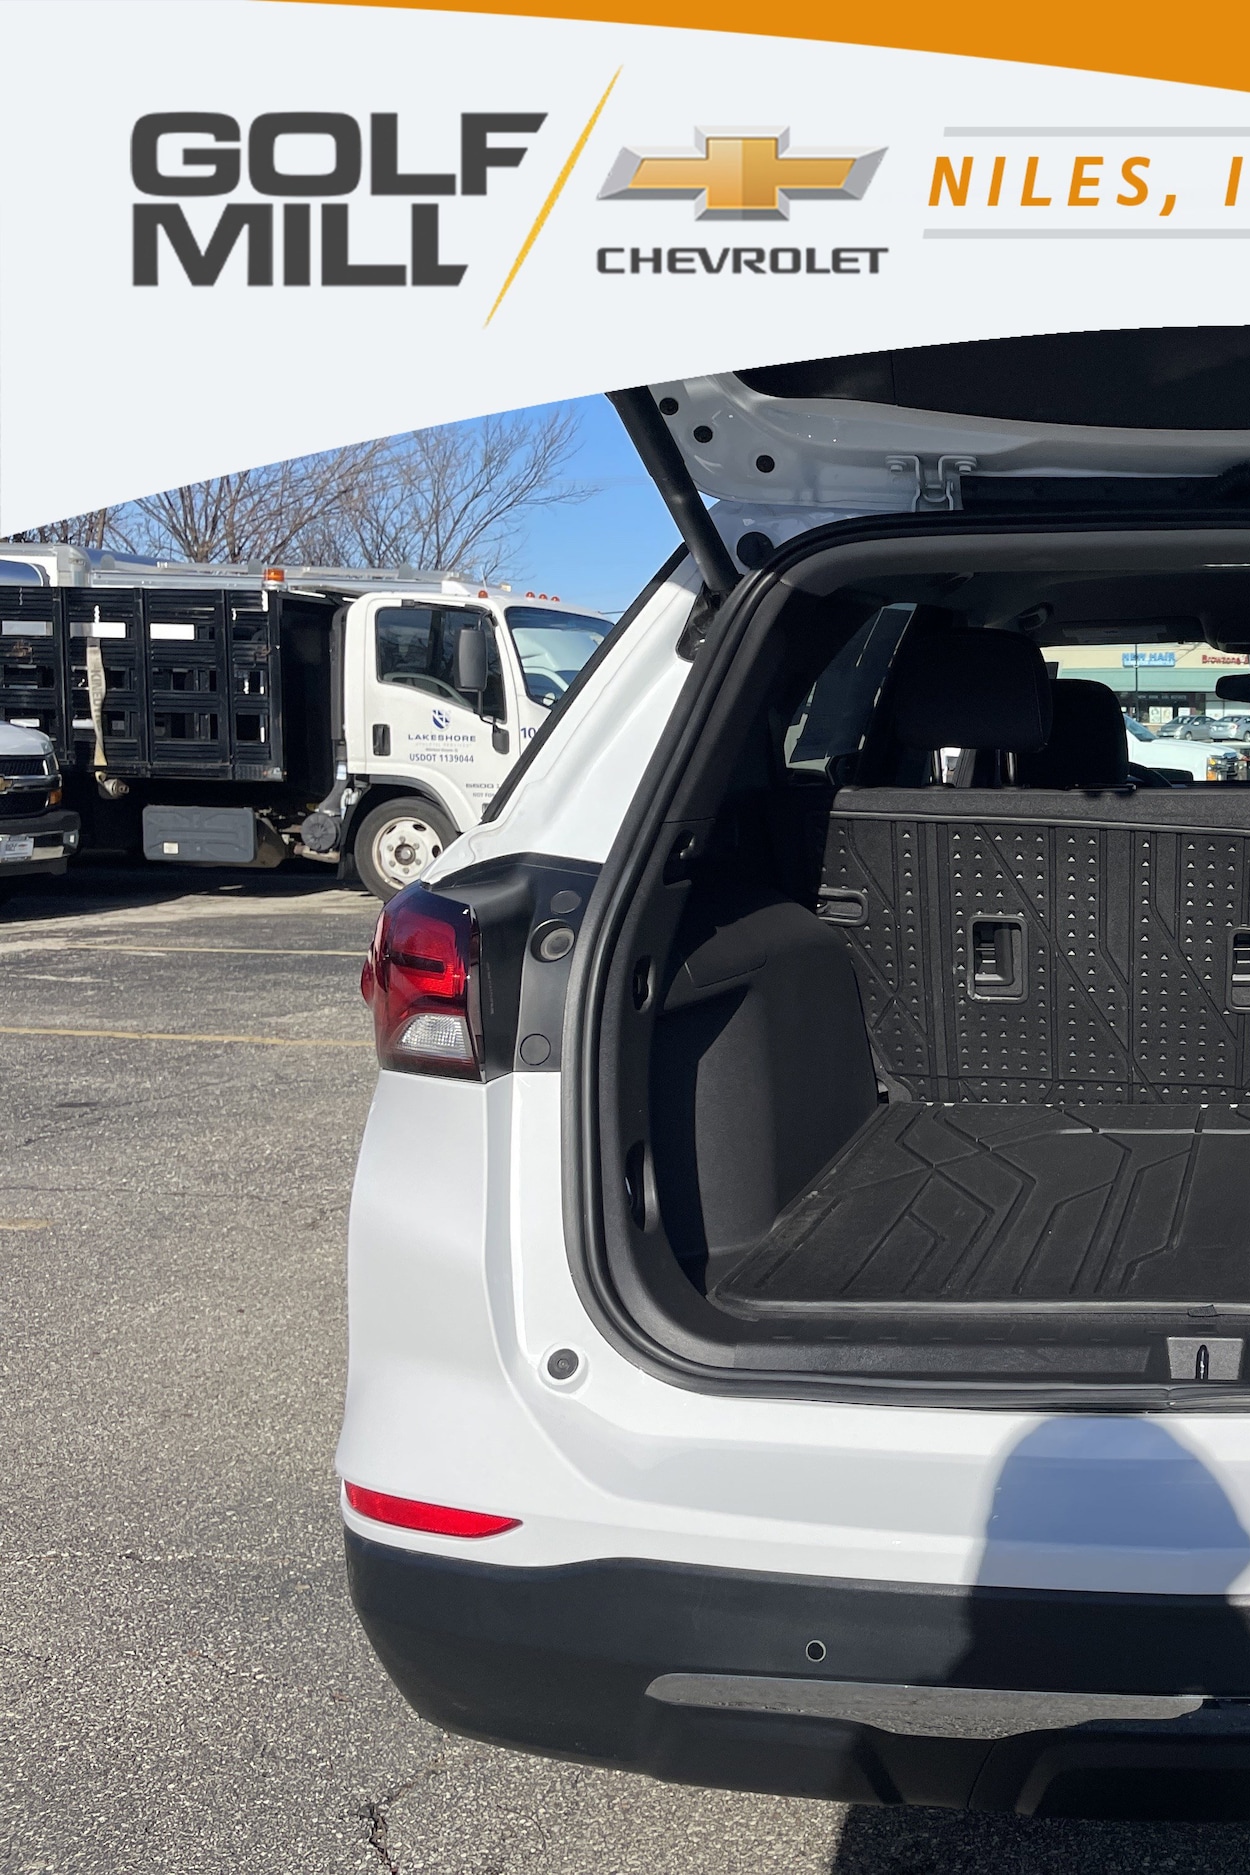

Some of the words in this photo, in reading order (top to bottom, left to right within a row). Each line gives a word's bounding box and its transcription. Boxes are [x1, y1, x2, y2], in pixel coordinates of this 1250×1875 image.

[1149, 652, 1175, 662] HAIR
[408, 734, 476, 742] LAKESHORE
[409, 753, 436, 762] USDOT
[439, 754, 474, 763] 1139044
